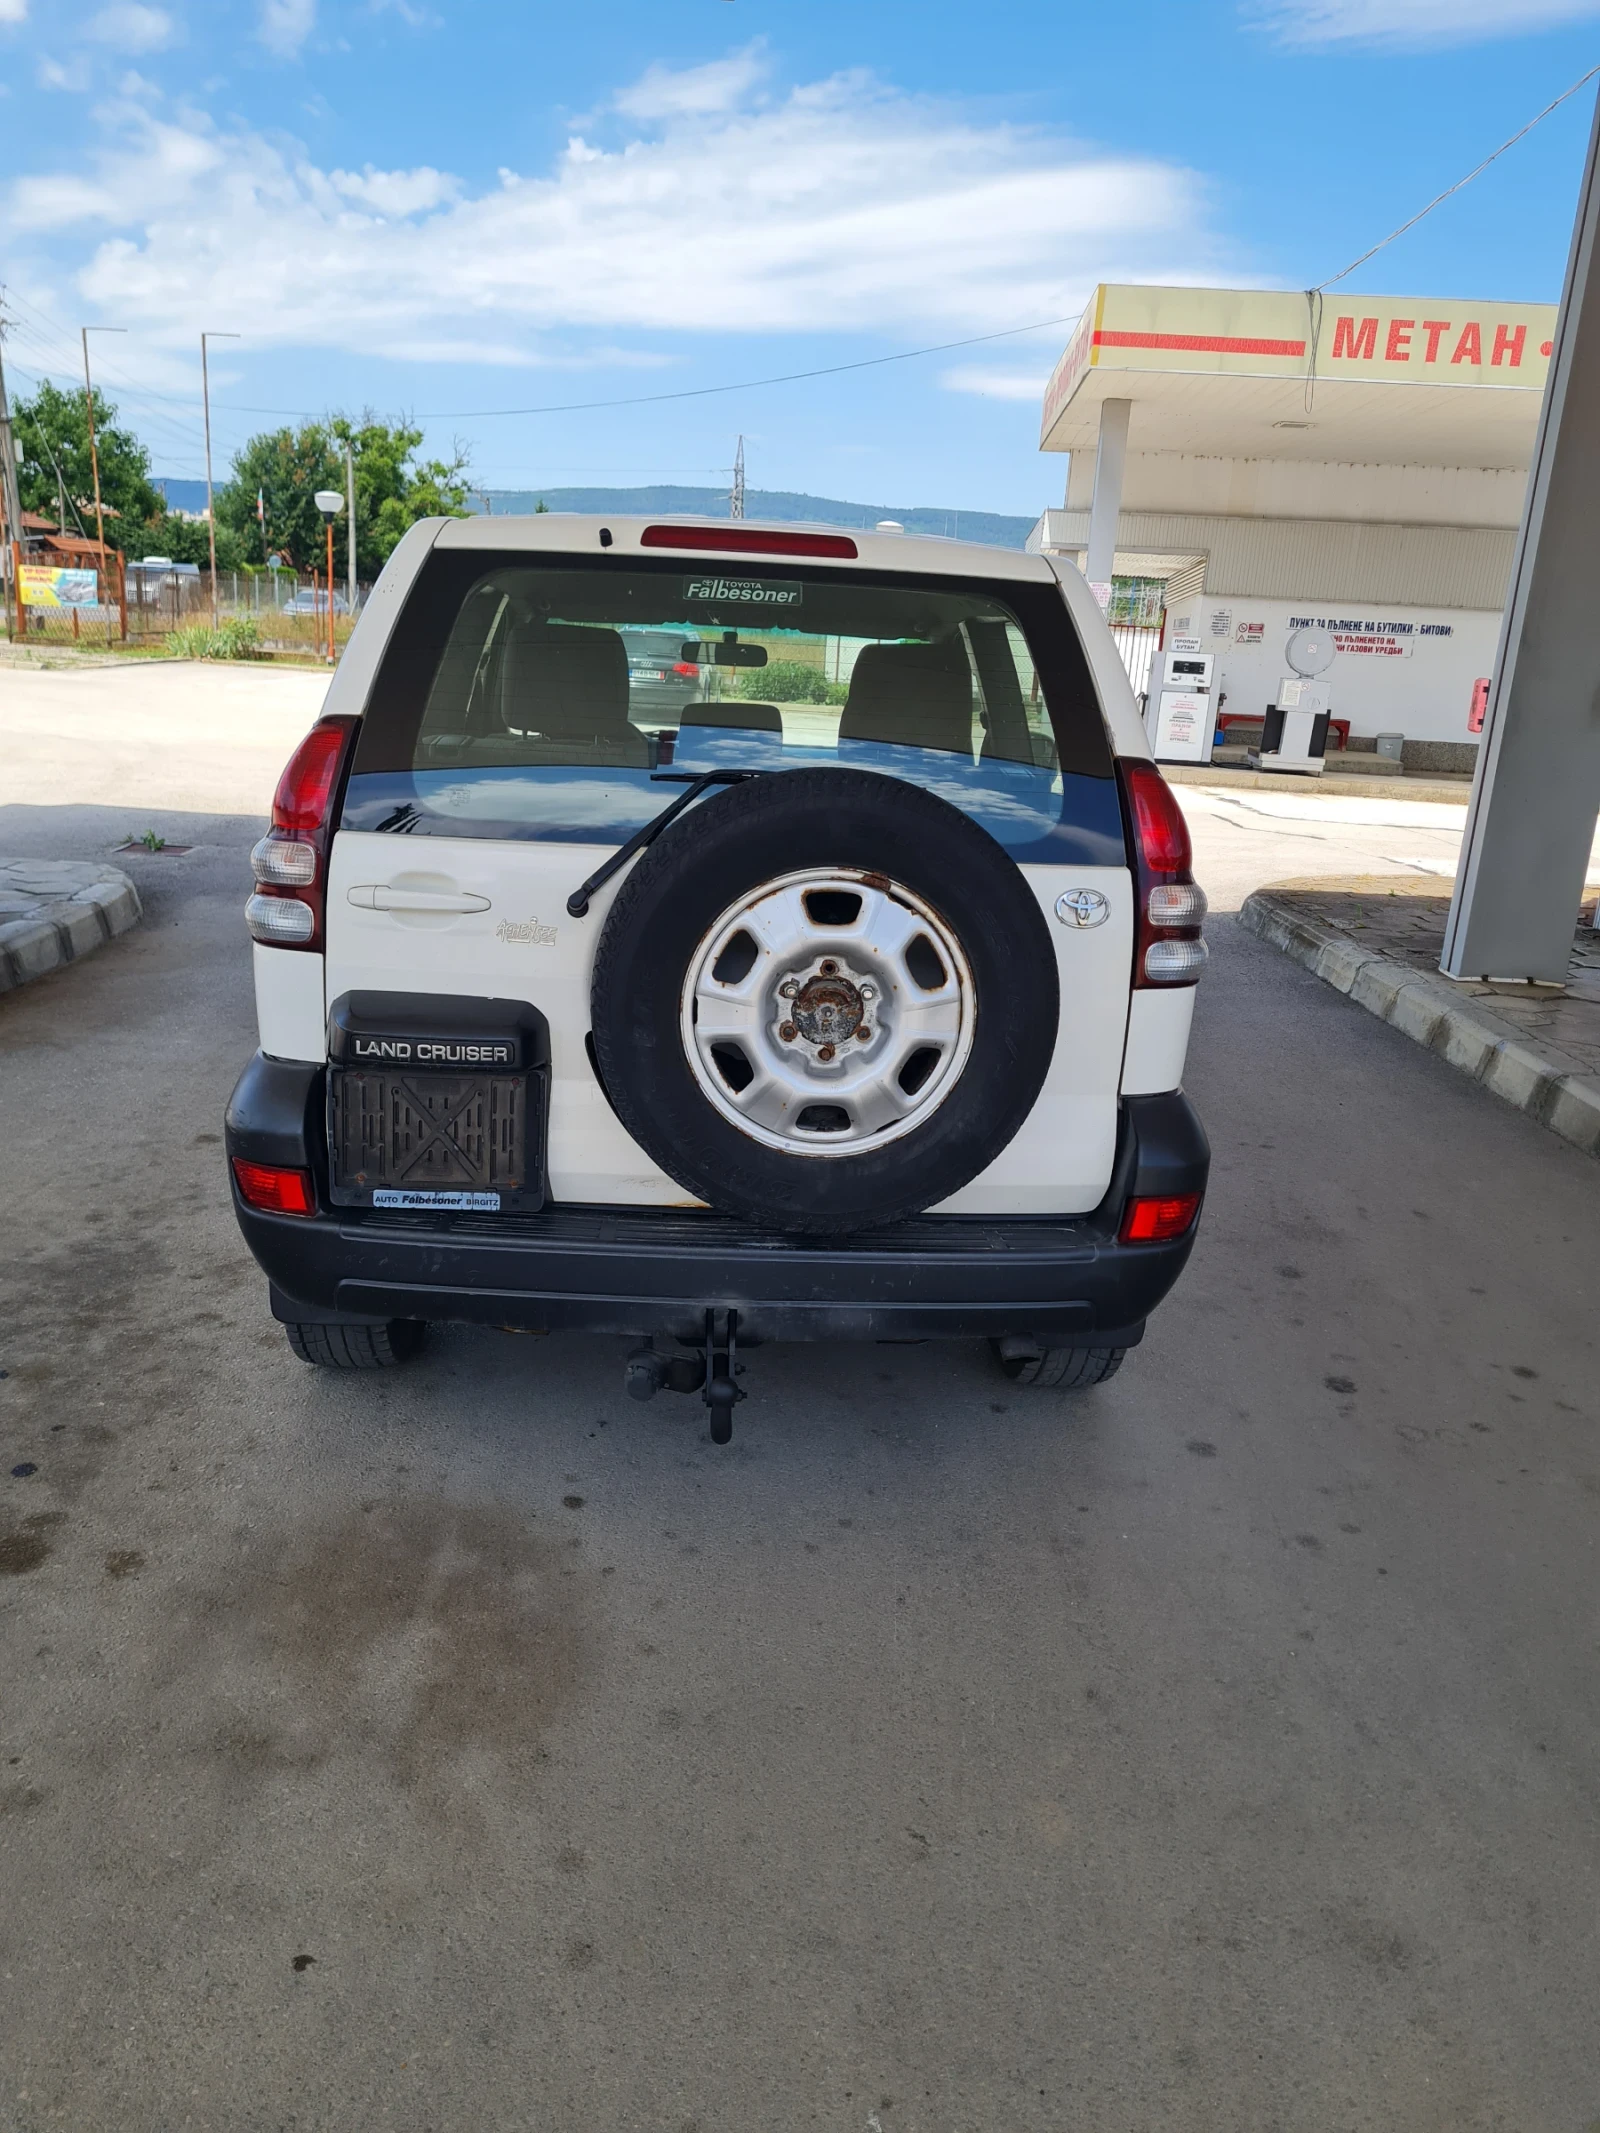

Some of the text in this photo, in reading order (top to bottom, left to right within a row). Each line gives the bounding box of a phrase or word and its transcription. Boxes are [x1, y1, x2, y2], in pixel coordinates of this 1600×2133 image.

[1332, 316, 1528, 367] МЕТАН
[687, 579, 797, 603] Falbesoner
[725, 580, 762, 589] TOYOTA
[1289, 617, 1315, 628] ПУНКТ
[1327, 619, 1364, 632] ПЪЛНЕНЕ
[1364, 621, 1375, 632] НА
[1376, 622, 1414, 634] БУТИЛКИ
[1420, 624, 1452, 636] БИТОВИ
[1344, 635, 1385, 645] ПЪЛНЕНЕТО
[1386, 637, 1396, 645] НА
[1346, 644, 1374, 653] ГАЗОВИ
[1375, 646, 1404, 655] УРЕДБИ
[355, 1040, 508, 1062] LAND CRUISER
[375, 1194, 499, 1207] AUTO Falbesoner BIRGITZ
